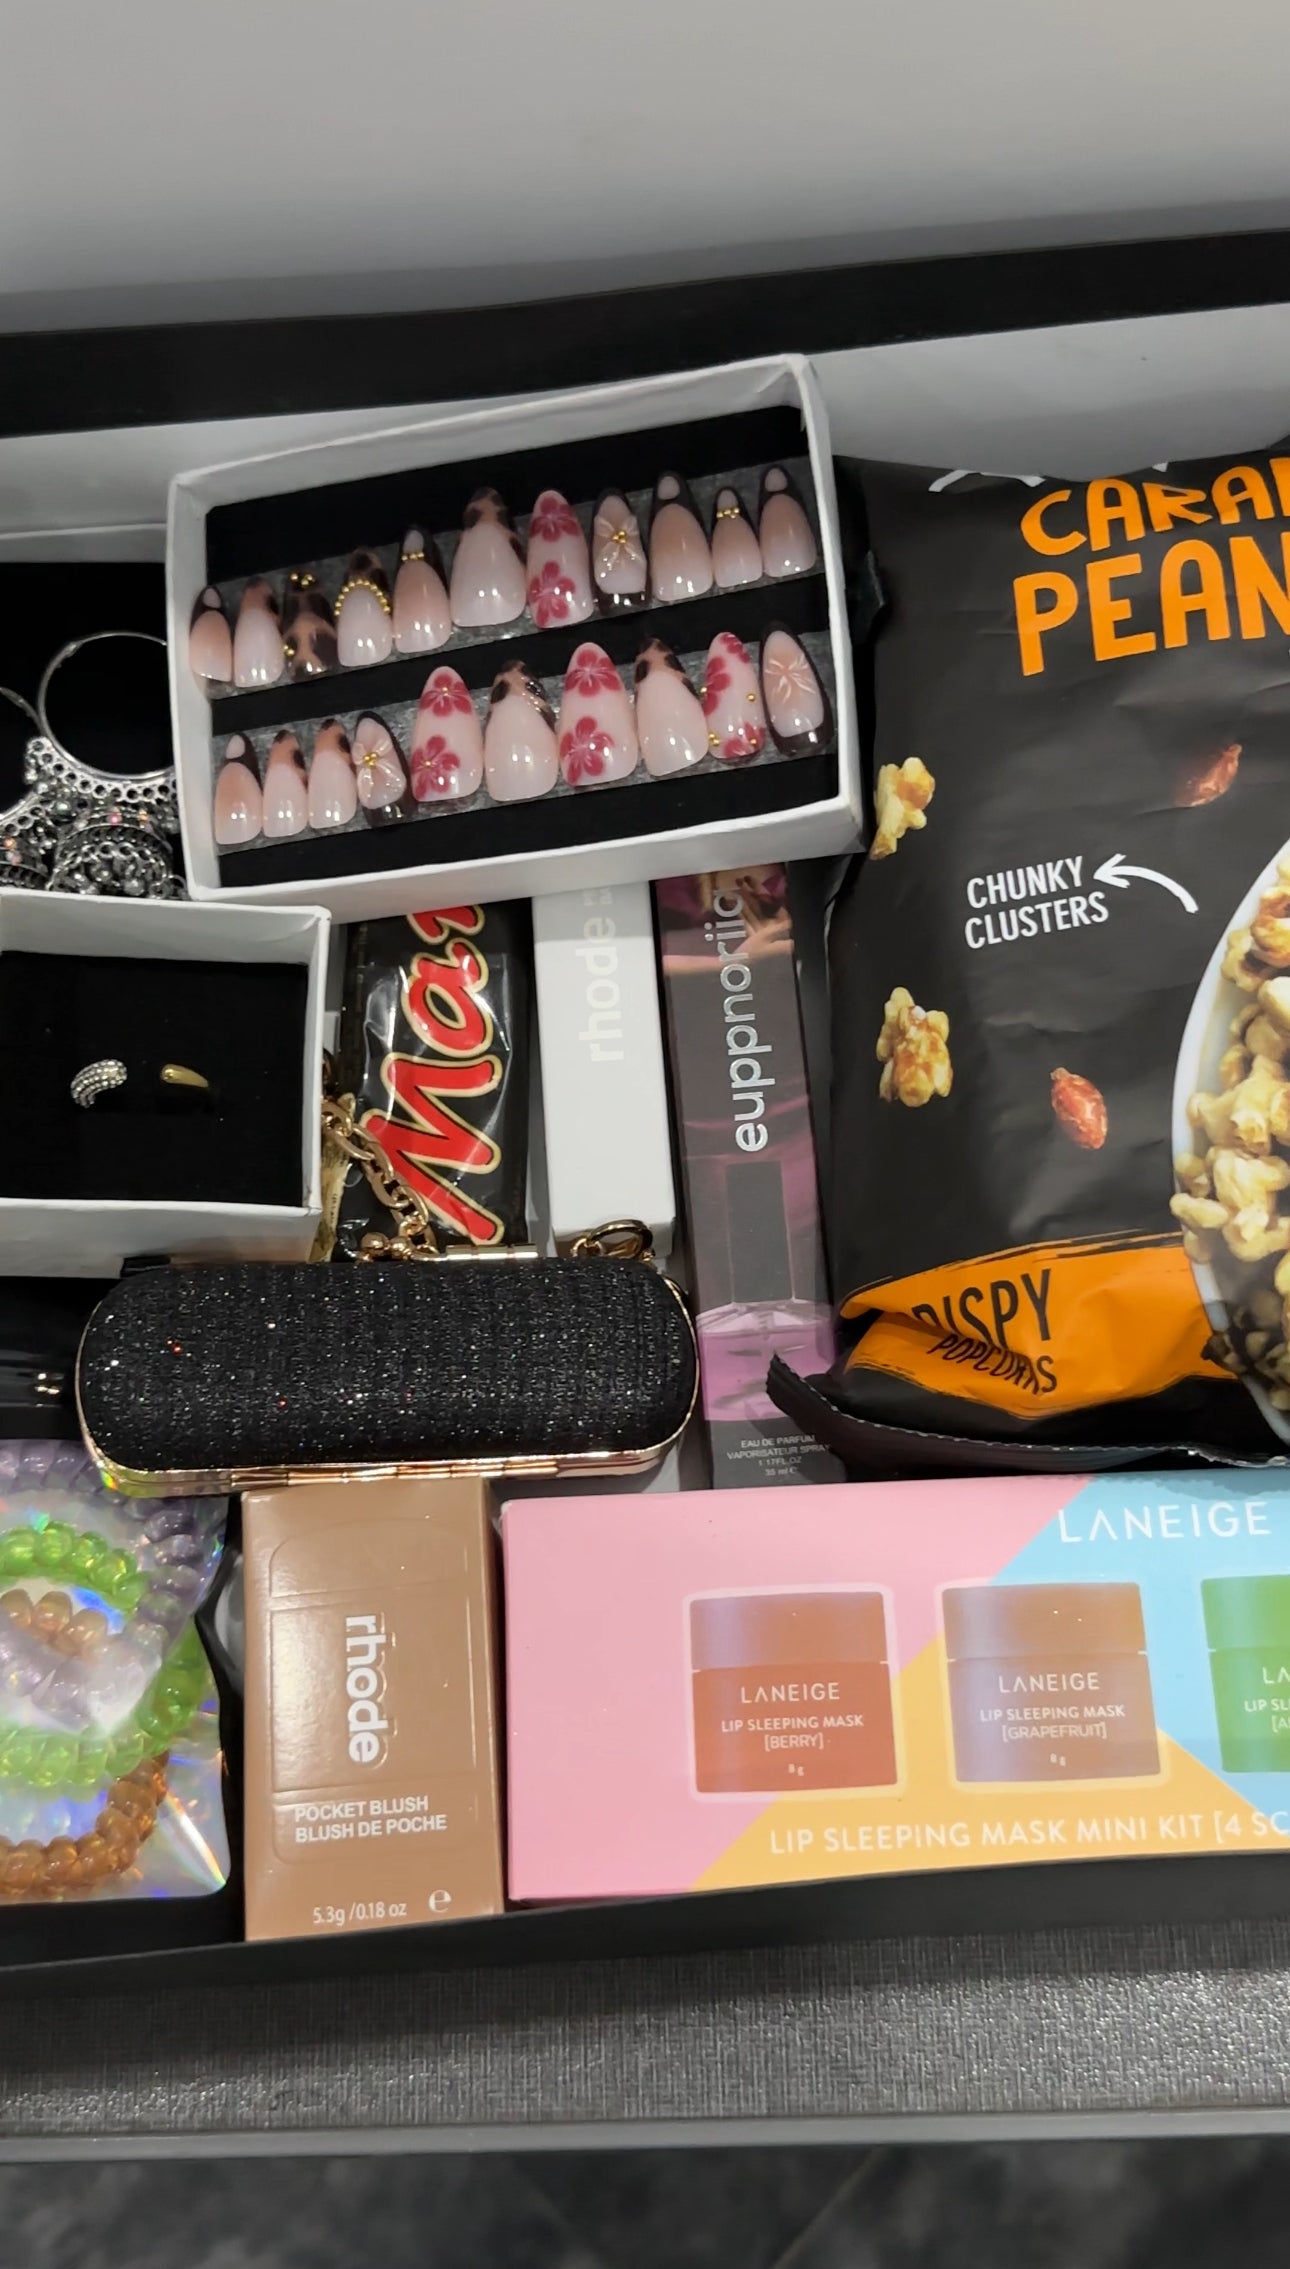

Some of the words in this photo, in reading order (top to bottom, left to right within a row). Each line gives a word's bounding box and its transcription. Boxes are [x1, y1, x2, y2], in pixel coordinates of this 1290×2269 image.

[1020, 457, 1290, 556] CARA
[966, 855, 1084, 909] CHUNKY
[964, 891, 1110, 949] CLUSTERS
[575, 916, 625, 1062] rhode
[726, 1446, 798, 1460] VAPORISATEUR
[741, 1438, 761, 1448] EAU
[762, 1437, 776, 1447] DE
[1057, 1501, 1273, 1543] LANEIGE
[346, 1615, 389, 1763] rhode
[740, 1682, 841, 1704] LANEIGE
[998, 1672, 1100, 1694] LANEIGE
[979, 1708, 1003, 1722] LIP
[1006, 1706, 1080, 1721] SLEEPING
[1083, 1704, 1126, 1718] MASK
[1244, 1698, 1268, 1712] LIP
[721, 1719, 744, 1733] LIP
[747, 1716, 819, 1731] SLEEPING
[822, 1714, 864, 1728] MASK
[1002, 1721, 1108, 1743] [GRAPEFRUIT]
[764, 1732, 825, 1752] [BERRY]
[295, 1801, 366, 1822] POCKET
[369, 1795, 429, 1816] BLUSH
[295, 1823, 355, 1843] BLUSH
[357, 1820, 383, 1838] DE
[386, 1814, 448, 1835] POCHE
[770, 1829, 814, 1854] LIP
[823, 1822, 971, 1852] SLEEPING
[981, 1819, 1068, 1846] MASK
[1077, 1816, 1148, 1843] MINI
[1159, 1814, 1204, 1840] KIT
[1214, 1810, 1243, 1844] [4
[313, 1905, 346, 1926] 5.3g
[388, 1903, 408, 1917] oz
